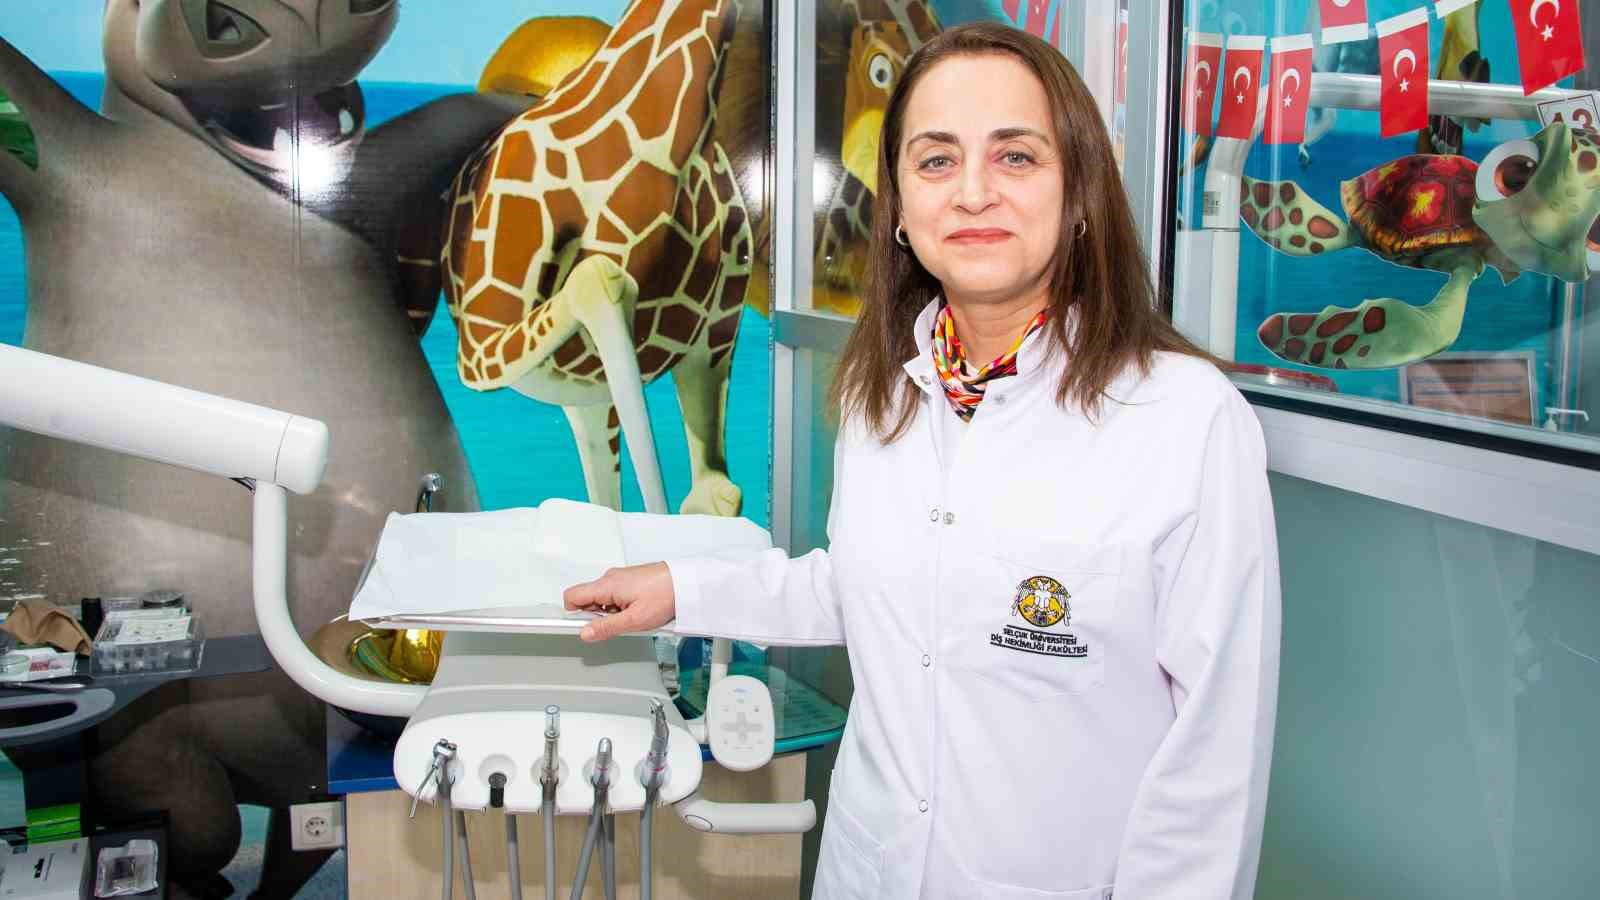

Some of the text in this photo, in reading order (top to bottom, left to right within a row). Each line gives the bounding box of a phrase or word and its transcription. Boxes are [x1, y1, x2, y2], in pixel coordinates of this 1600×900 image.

[991, 632, 1088, 653] DİŞ HEKİMLİĞİ FAKÜLTESİ
[1003, 628, 1077, 645] SELÇUK ÜNİVERSİTESİ
